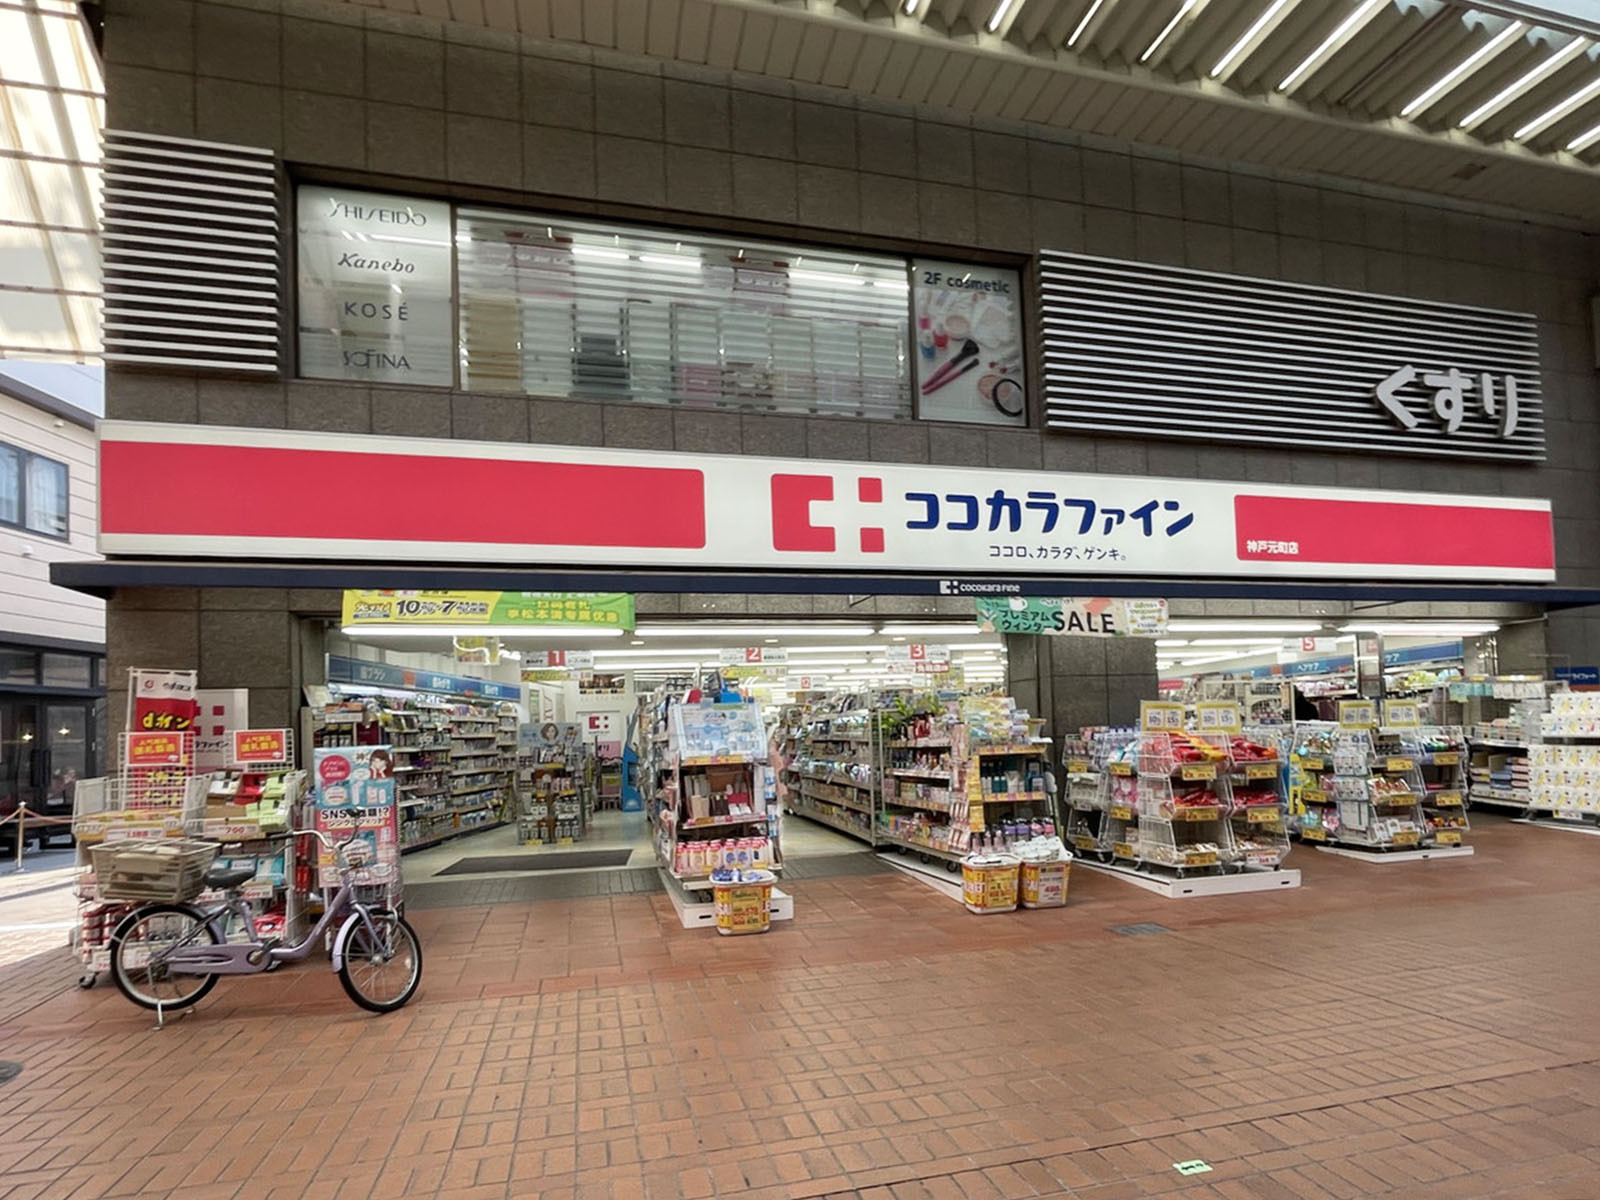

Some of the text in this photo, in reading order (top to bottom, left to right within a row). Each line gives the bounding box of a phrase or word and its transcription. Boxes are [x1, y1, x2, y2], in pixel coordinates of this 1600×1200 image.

[330, 202, 427, 227] SHISEIDO
[337, 253, 415, 273] Kanebo
[924, 271, 1010, 294] 2F cosmetic
[345, 302, 408, 321] KOSÉ
[343, 349, 412, 370] SOFINA
[1376, 364, 1518, 437] くすり
[905, 489, 1194, 537] ココカラファイン
[999, 610, 1050, 621] プレミアム
[1051, 611, 1116, 633] SALE
